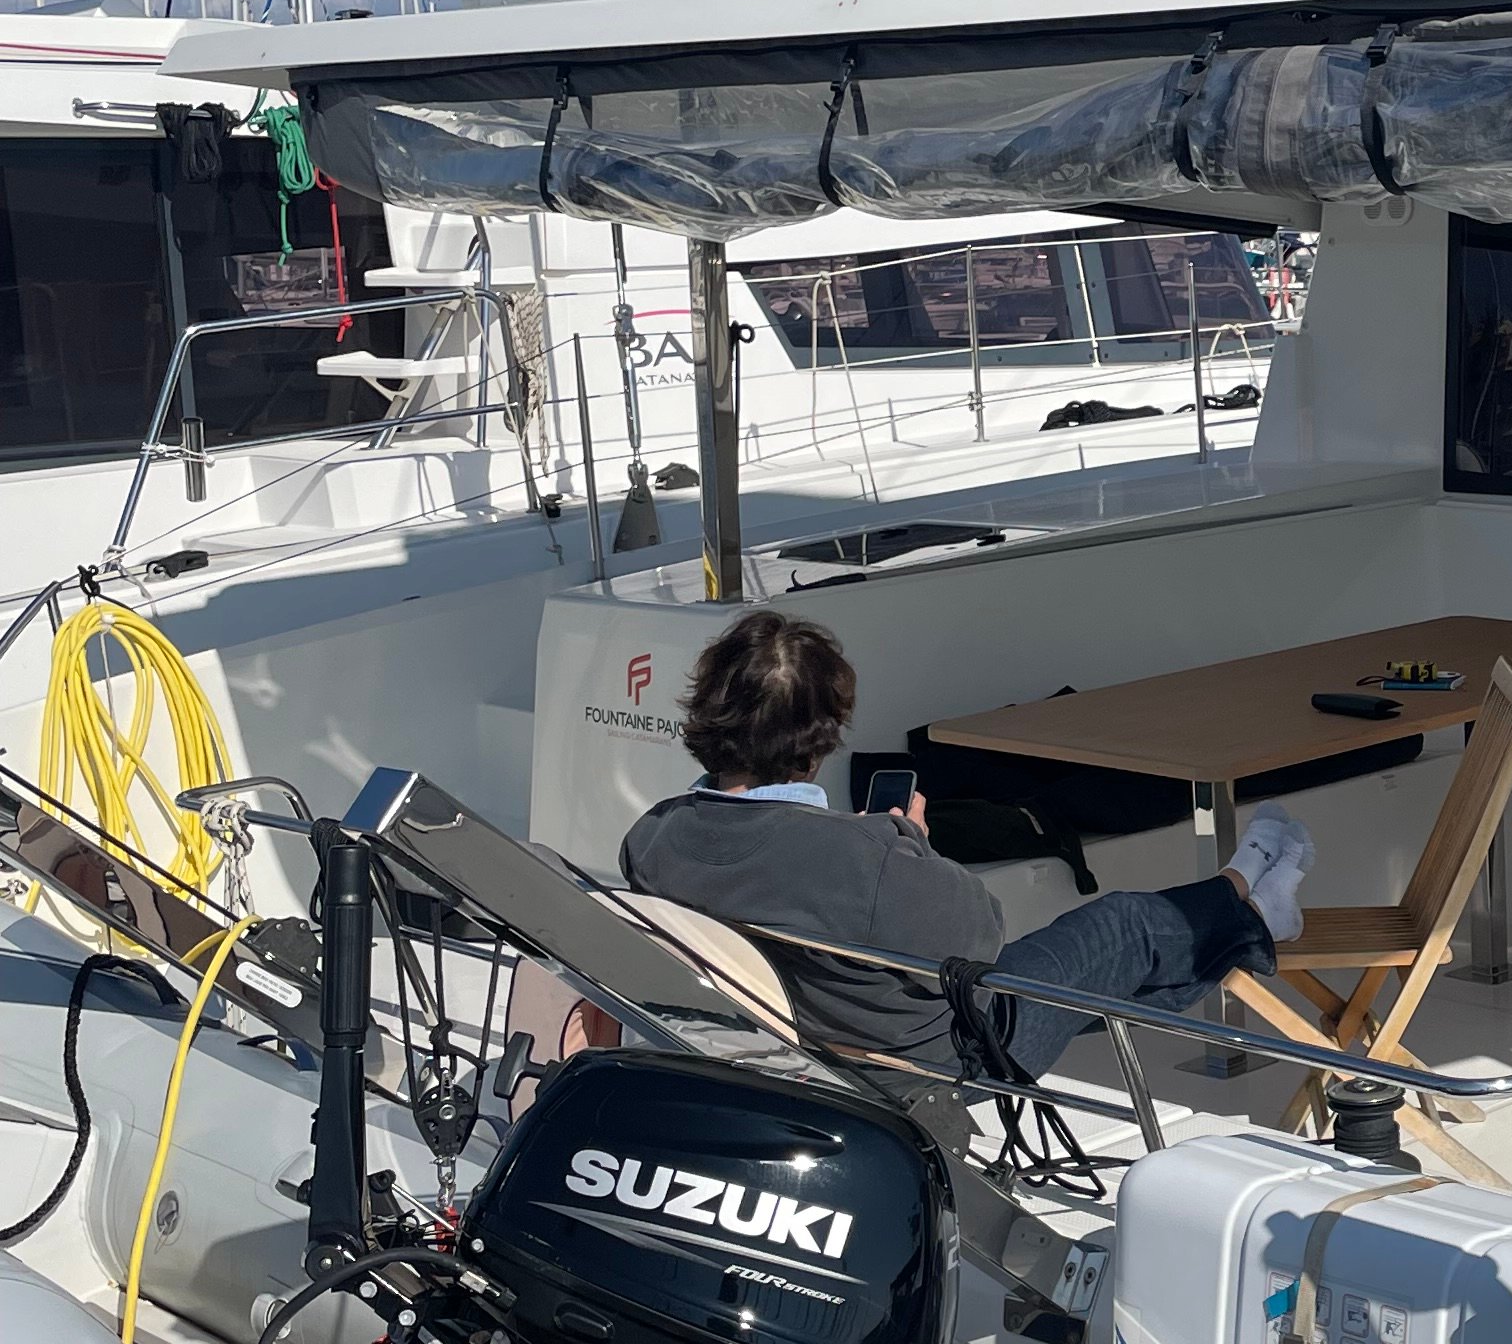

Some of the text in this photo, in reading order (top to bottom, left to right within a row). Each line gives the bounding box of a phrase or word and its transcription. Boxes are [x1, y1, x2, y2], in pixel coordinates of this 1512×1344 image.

[628, 331, 694, 368] BA
[637, 372, 695, 386] ATANA
[585, 706, 654, 732] FOUNTAINE
[657, 717, 688, 740] PAJO
[565, 1148, 854, 1260] SUZUKI
